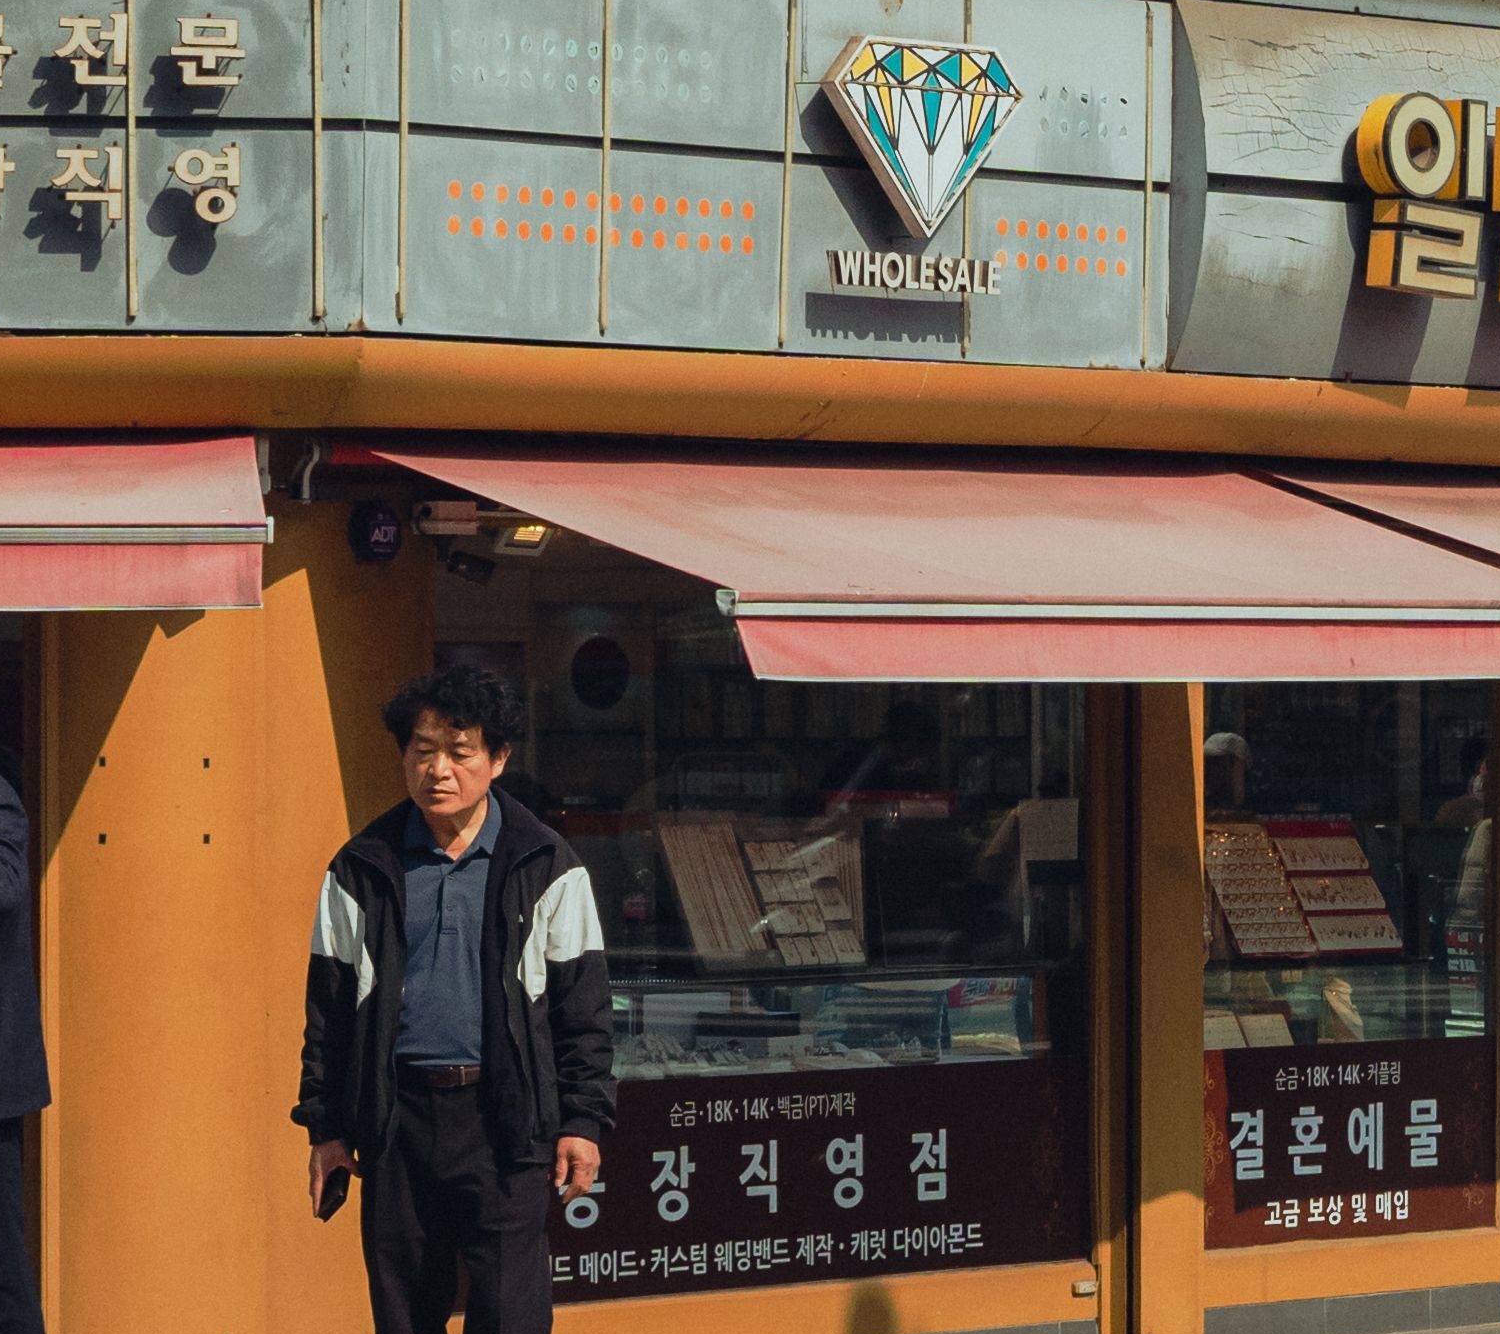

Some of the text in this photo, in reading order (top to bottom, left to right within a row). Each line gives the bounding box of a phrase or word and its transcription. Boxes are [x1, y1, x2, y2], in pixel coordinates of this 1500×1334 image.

[826, 247, 1005, 297] WHOLESALE
[370, 525, 397, 544] ADT
[1229, 1097, 1443, 1182] 결혼예물
[1263, 1189, 1410, 1229] 고금 보상 및 매입
[549, 1254, 574, 1283] 드
[713, 1237, 791, 1273] 웨딩밴드
[796, 1233, 835, 1266] 제작
[850, 1227, 888, 1261] 캐럿
[893, 1222, 985, 1255] 다이아몬드
